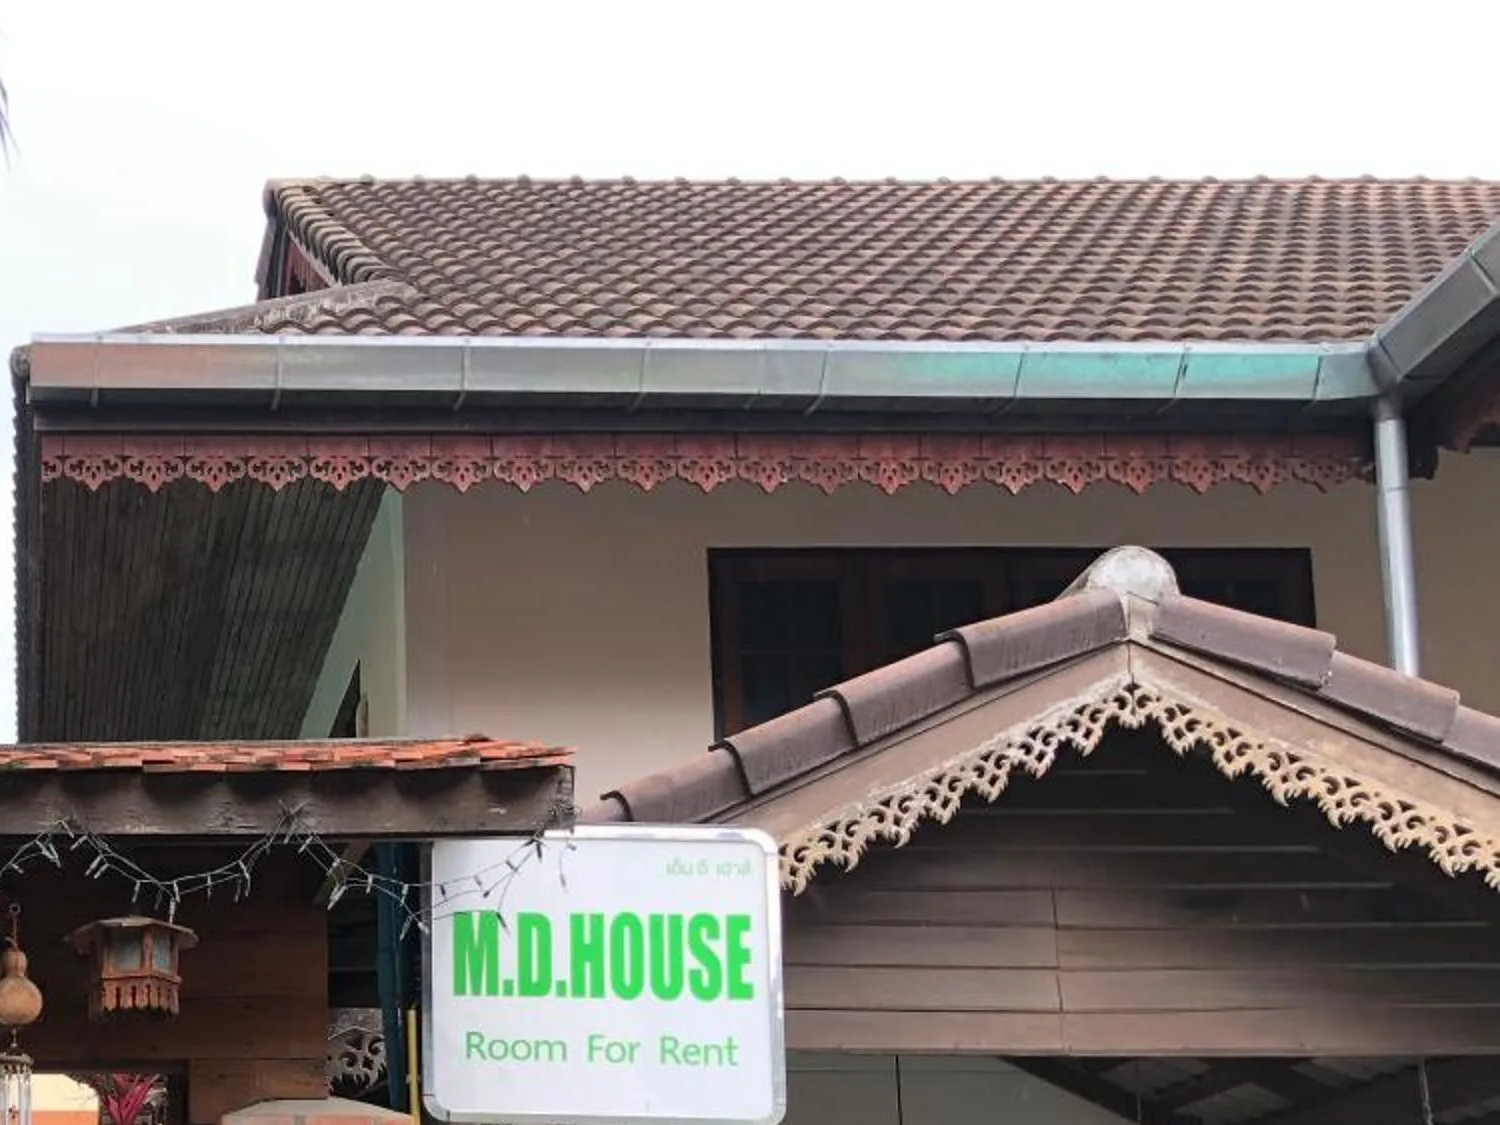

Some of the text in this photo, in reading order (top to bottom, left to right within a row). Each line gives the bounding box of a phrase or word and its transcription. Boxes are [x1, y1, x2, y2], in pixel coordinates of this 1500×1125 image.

[452, 909, 755, 1002] M.D.HOUSE
[465, 1031, 739, 1067] Room For Rent
